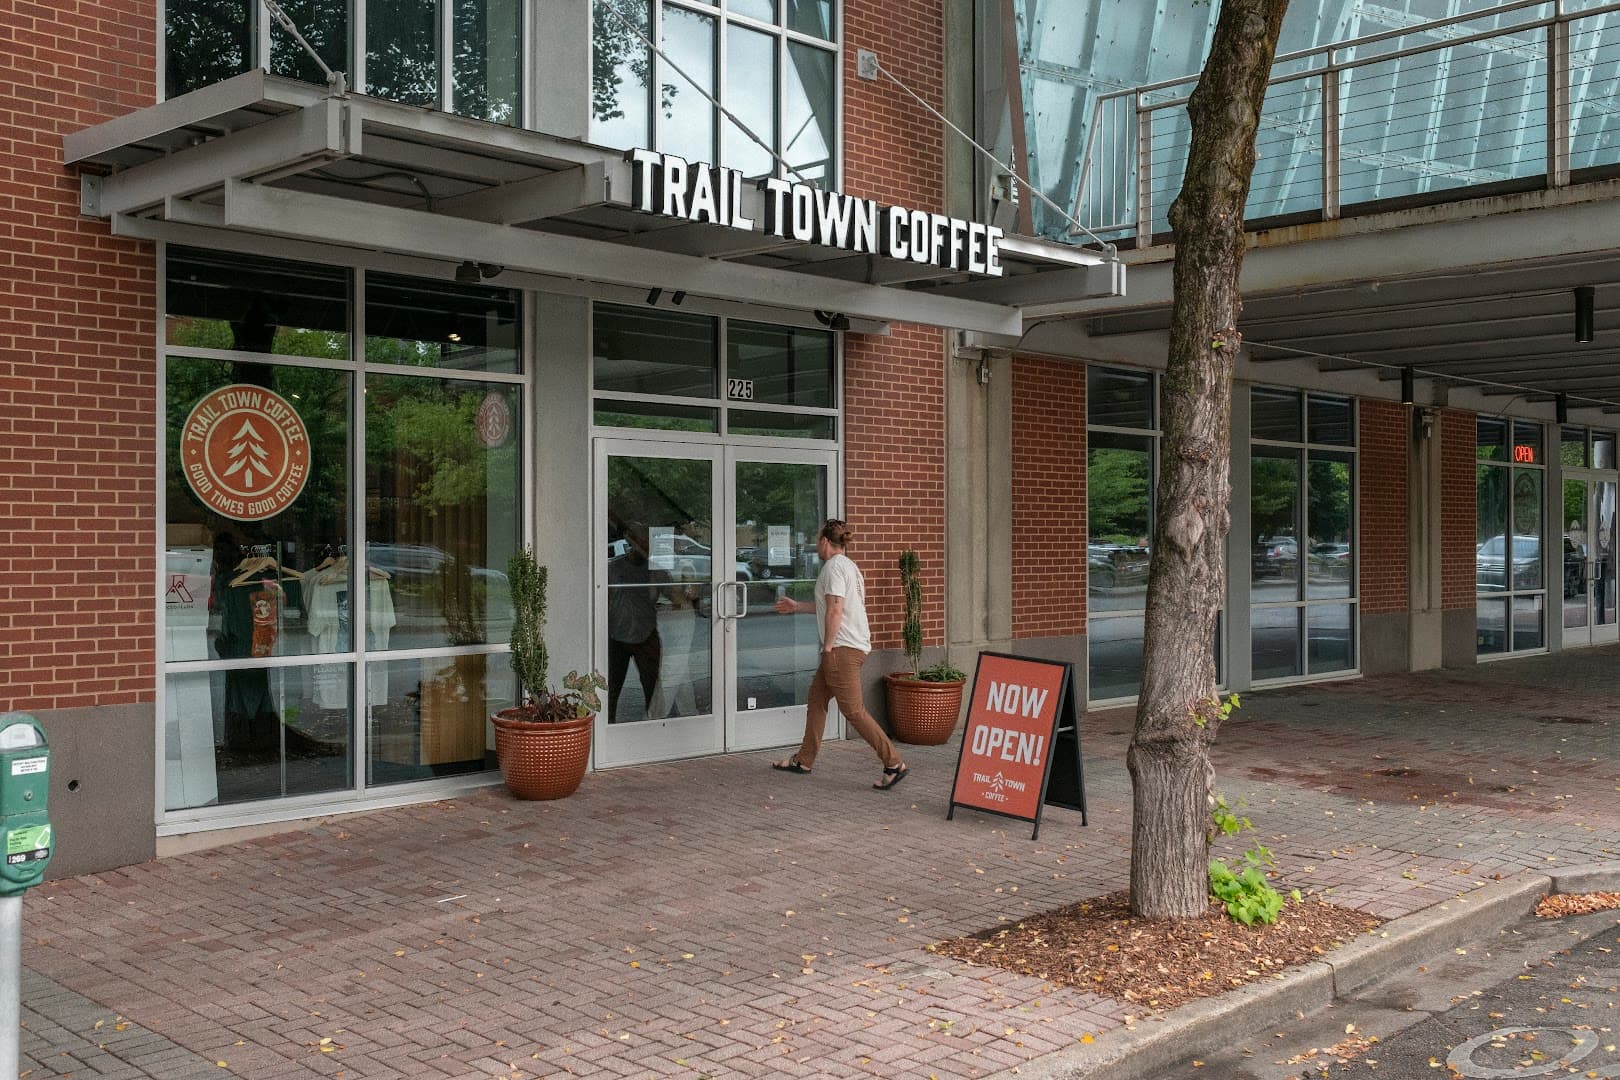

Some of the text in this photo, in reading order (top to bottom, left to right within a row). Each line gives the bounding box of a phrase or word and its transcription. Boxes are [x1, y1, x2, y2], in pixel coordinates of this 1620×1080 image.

[633, 149, 1004, 277] TRAIL TOWN COFFEE
[729, 380, 752, 398] 225
[187, 391, 304, 445] TRAIL TOWN COFFEE
[1514, 445, 1534, 463] OPEN
[190, 463, 304, 515] GOOD TIMES GOOD COFFEE
[986, 681, 1049, 719] NOW
[971, 724, 1045, 767] OPEN!
[973, 772, 1026, 792] TRAIL TOWN
[985, 791, 1005, 802] COFFEE
